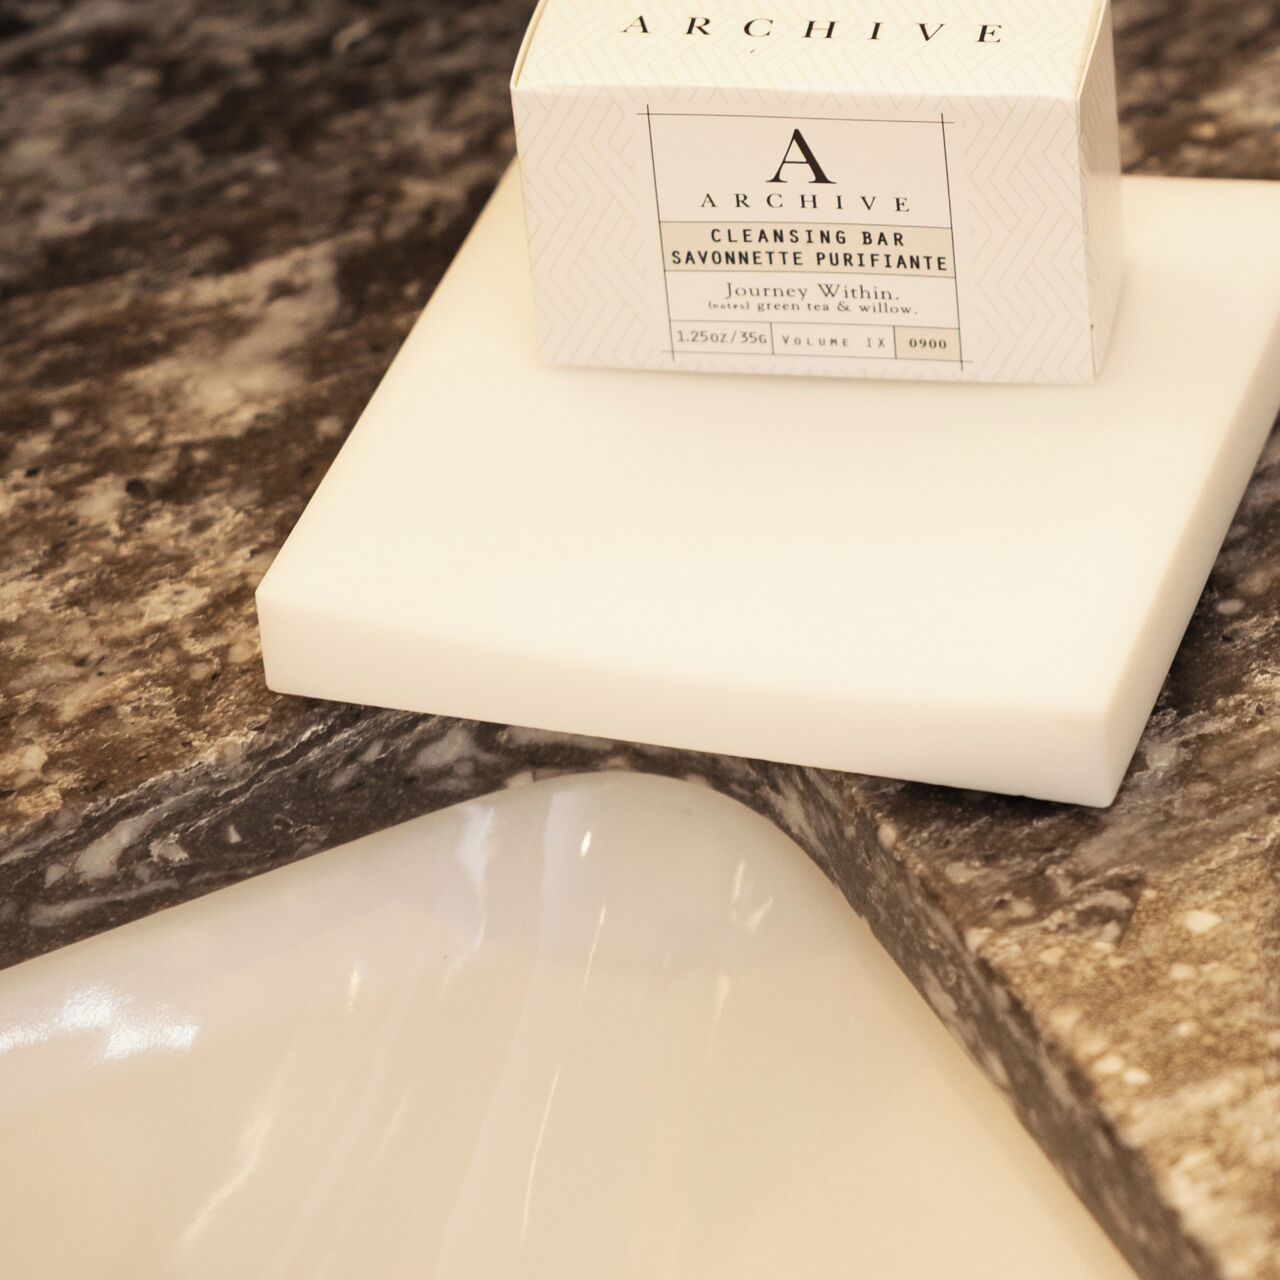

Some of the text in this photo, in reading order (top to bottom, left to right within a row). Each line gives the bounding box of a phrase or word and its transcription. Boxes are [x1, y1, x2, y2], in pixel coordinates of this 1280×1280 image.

[621, 15, 1003, 44] ARCHIVE
[765, 128, 837, 184] A
[700, 193, 910, 212] ARCHIVE
[711, 228, 905, 247] CLEANSING BAR
[671, 250, 948, 271] SAVONNETTE PURIFIANTE
[725, 282, 900, 300] Journey Within.
[757, 302, 800, 312] green
[807, 302, 830, 312] tea
[837, 301, 850, 312] &
[859, 303, 918, 314] willow.
[782, 336, 886, 349] VOLUME IX
[909, 338, 948, 350] 0900
